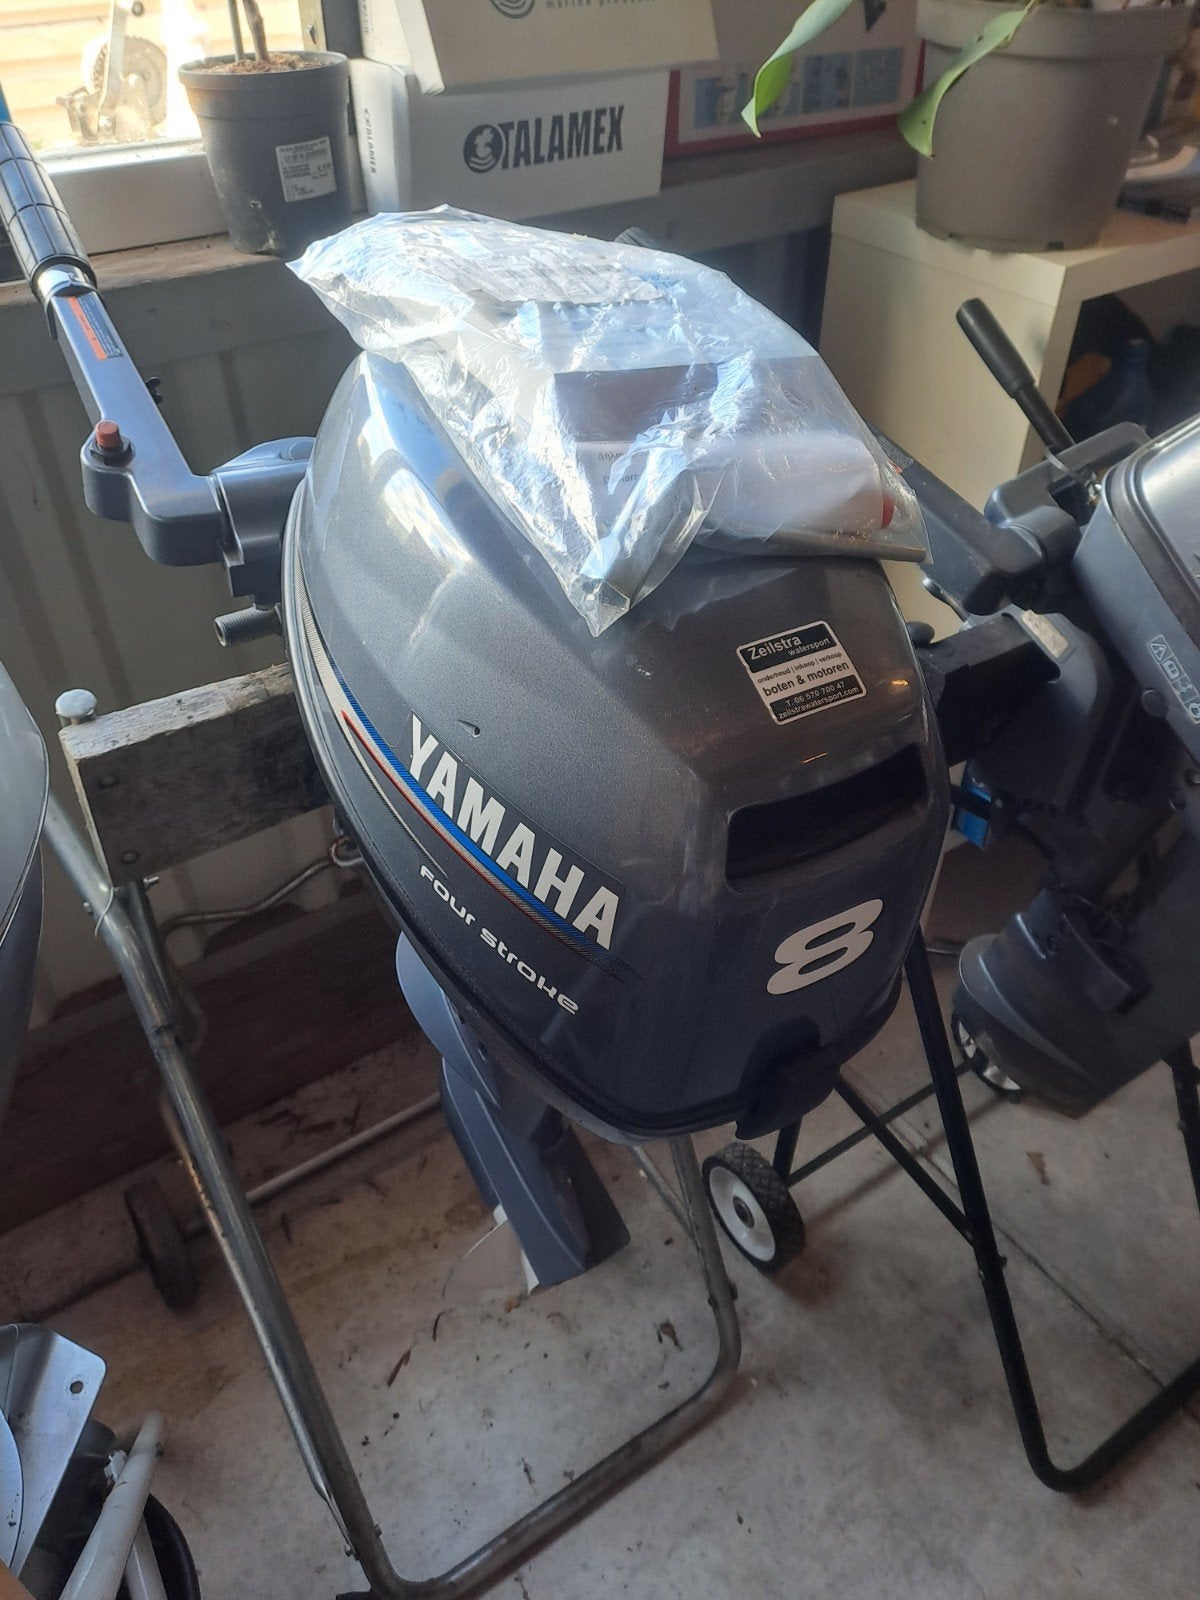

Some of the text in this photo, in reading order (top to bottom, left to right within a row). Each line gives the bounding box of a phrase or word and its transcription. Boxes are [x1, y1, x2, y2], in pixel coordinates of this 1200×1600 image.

[498, 105, 625, 170] TALAMEX
[747, 636, 802, 660] Zeilstra
[788, 637, 831, 657] watersport
[762, 662, 850, 697] boten & motoren
[778, 686, 860, 720] zeilstrawatersport.com
[409, 713, 620, 950] YAMAHA
[766, 898, 884, 995] 8
